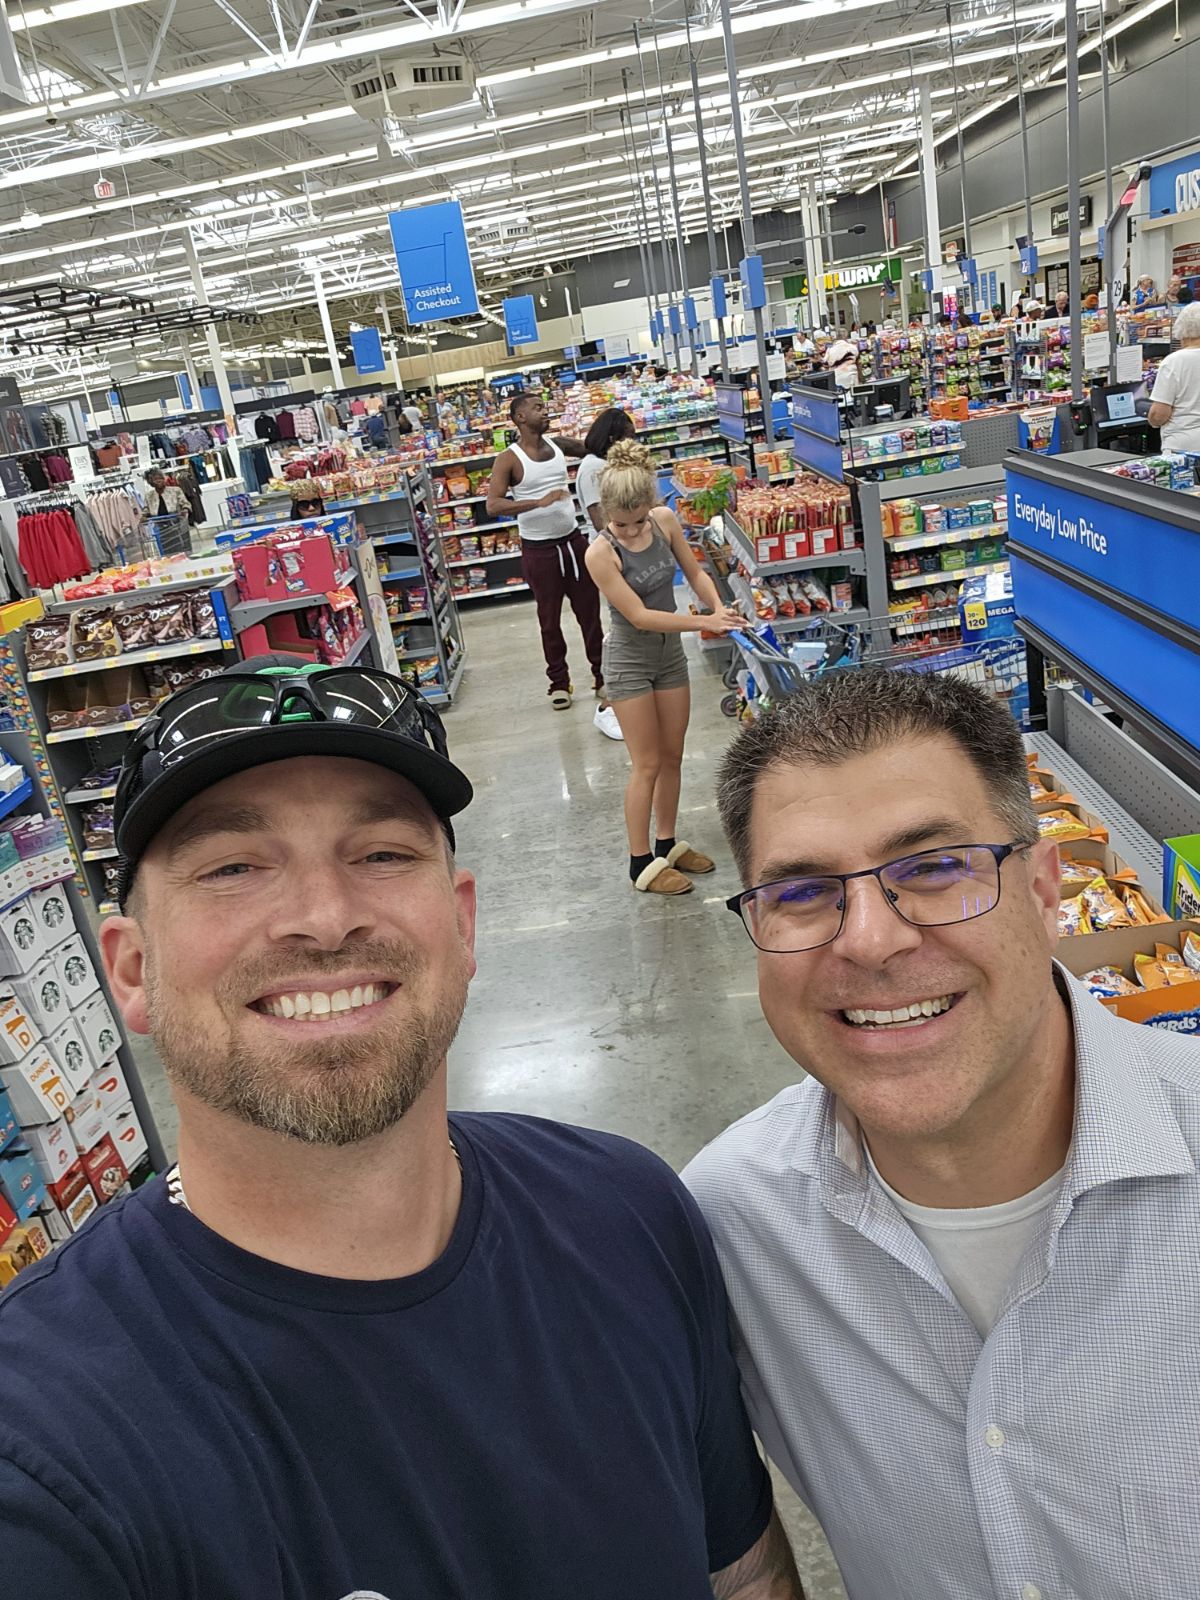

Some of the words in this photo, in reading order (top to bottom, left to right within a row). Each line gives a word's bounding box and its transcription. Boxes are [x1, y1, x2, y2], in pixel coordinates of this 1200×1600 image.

[414, 283, 452, 299] Assisted
[416, 296, 462, 311] Checkout
[1014, 494, 1056, 540] Everyday
[1057, 509, 1077, 542] Low
[1079, 517, 1107, 555] Price
[987, 606, 1014, 617] MEGA
[118, 612, 146, 626] Dove
[968, 618, 986, 628] 120
[32, 628, 60, 640] Dove
[76, 644, 95, 653] Dove
[27, 652, 46, 662] Dove
[169, 669, 195, 685] Dove
[19, 1031, 31, 1047] D
[54, 1091, 66, 1107] D
